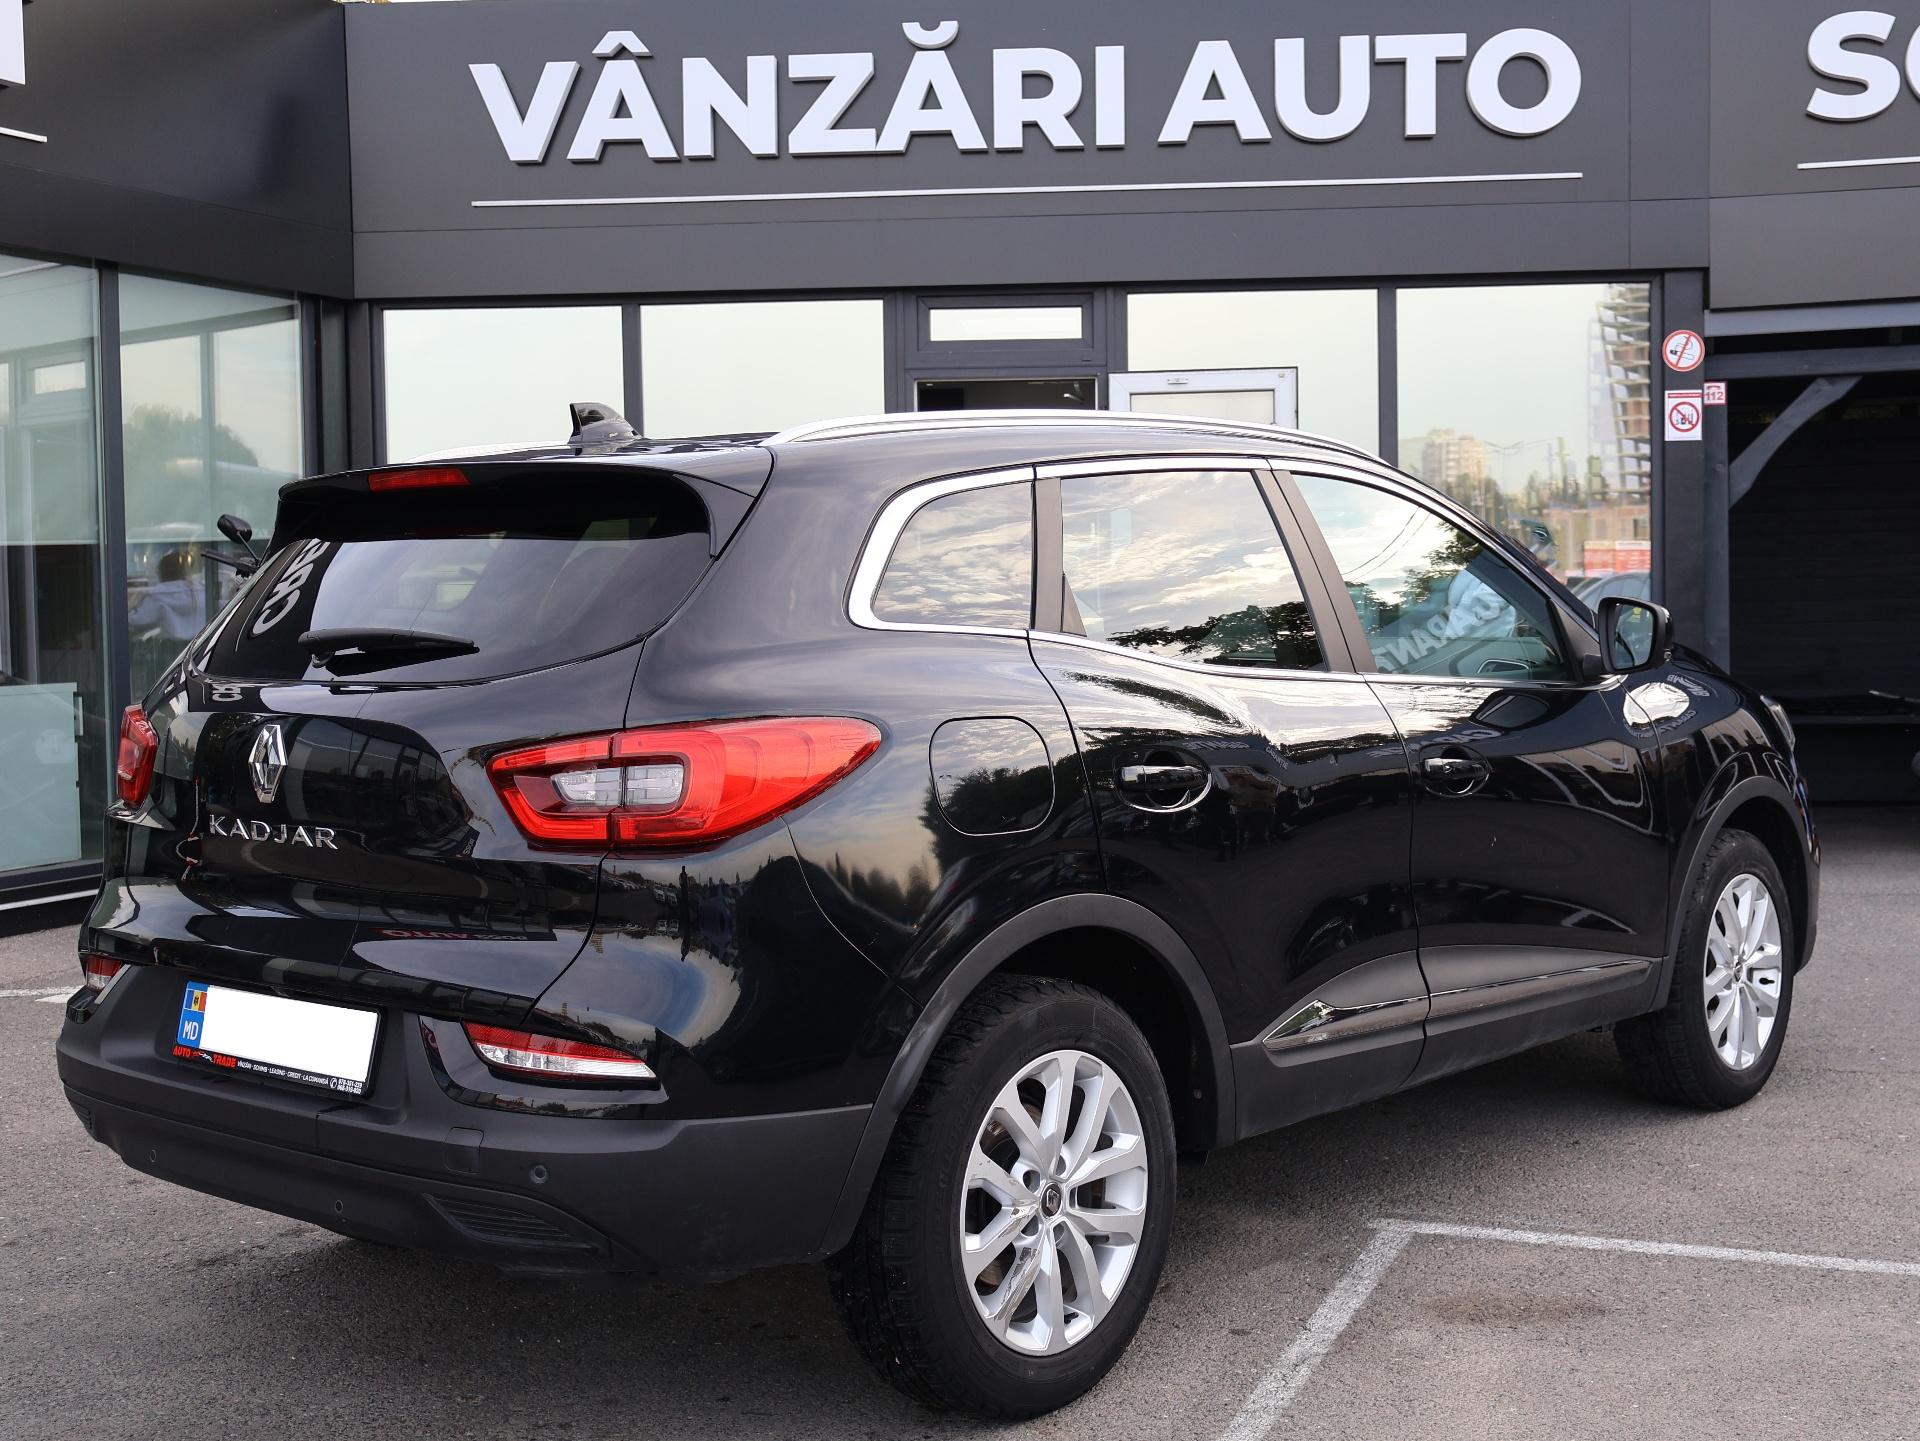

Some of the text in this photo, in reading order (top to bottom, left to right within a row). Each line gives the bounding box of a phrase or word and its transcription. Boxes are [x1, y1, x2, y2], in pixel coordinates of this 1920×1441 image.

[1806, 10, 1920, 120] S
[468, 20, 1583, 164] VÂNZĂRI AUTO
[1705, 391, 1724, 401] 112
[209, 814, 339, 850] KADJAR
[182, 1020, 199, 1041] MD
[172, 1045, 192, 1058] AUTO
[211, 1053, 238, 1069] TRADE
